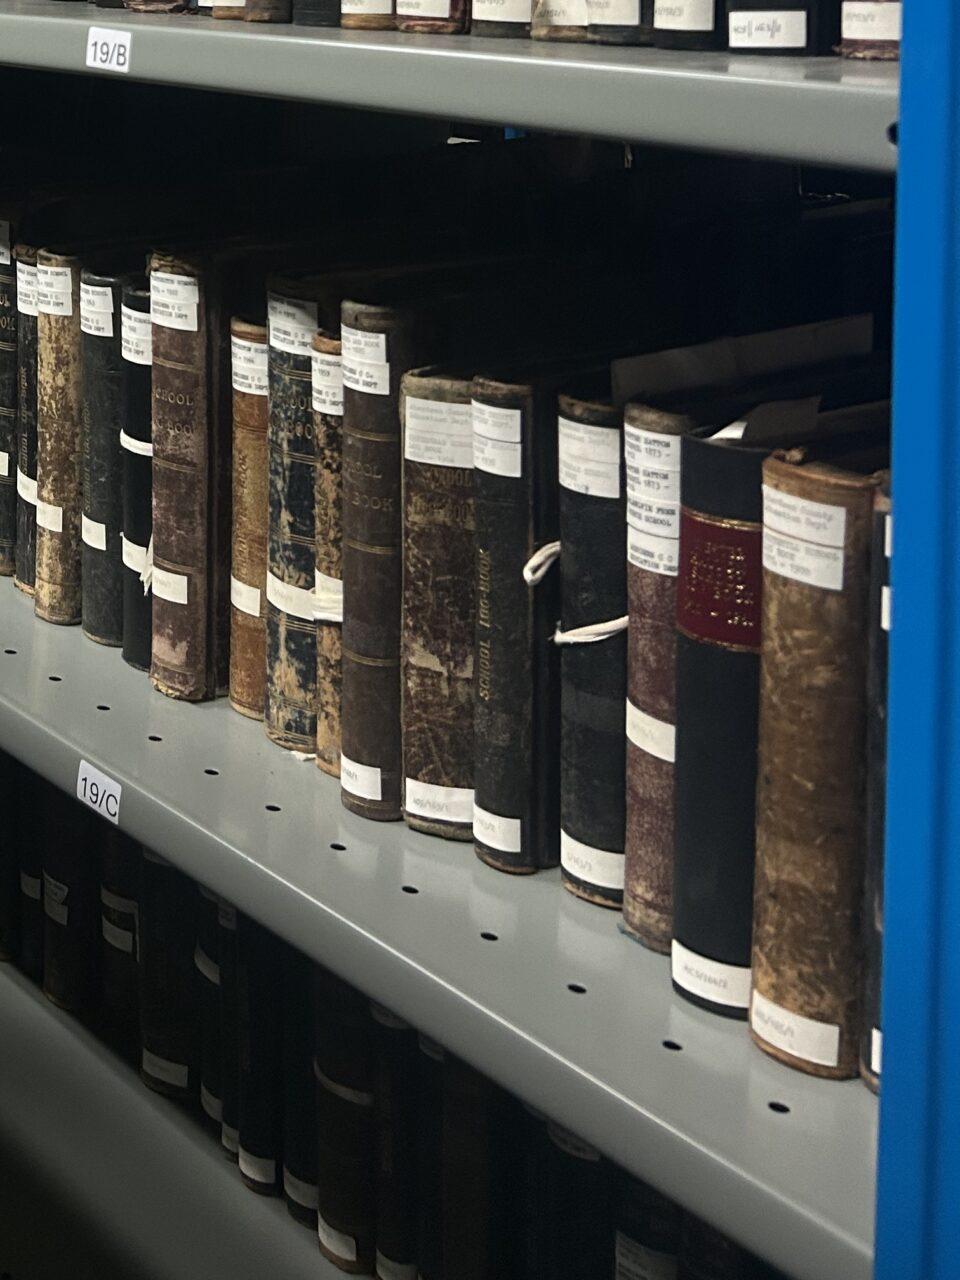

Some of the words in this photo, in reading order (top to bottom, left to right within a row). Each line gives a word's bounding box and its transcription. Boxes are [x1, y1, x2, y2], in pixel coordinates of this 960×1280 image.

[91, 40, 128, 67] 19/B
[479, 640, 490, 701] SCHOOL
[81, 776, 118, 818] 19/C
